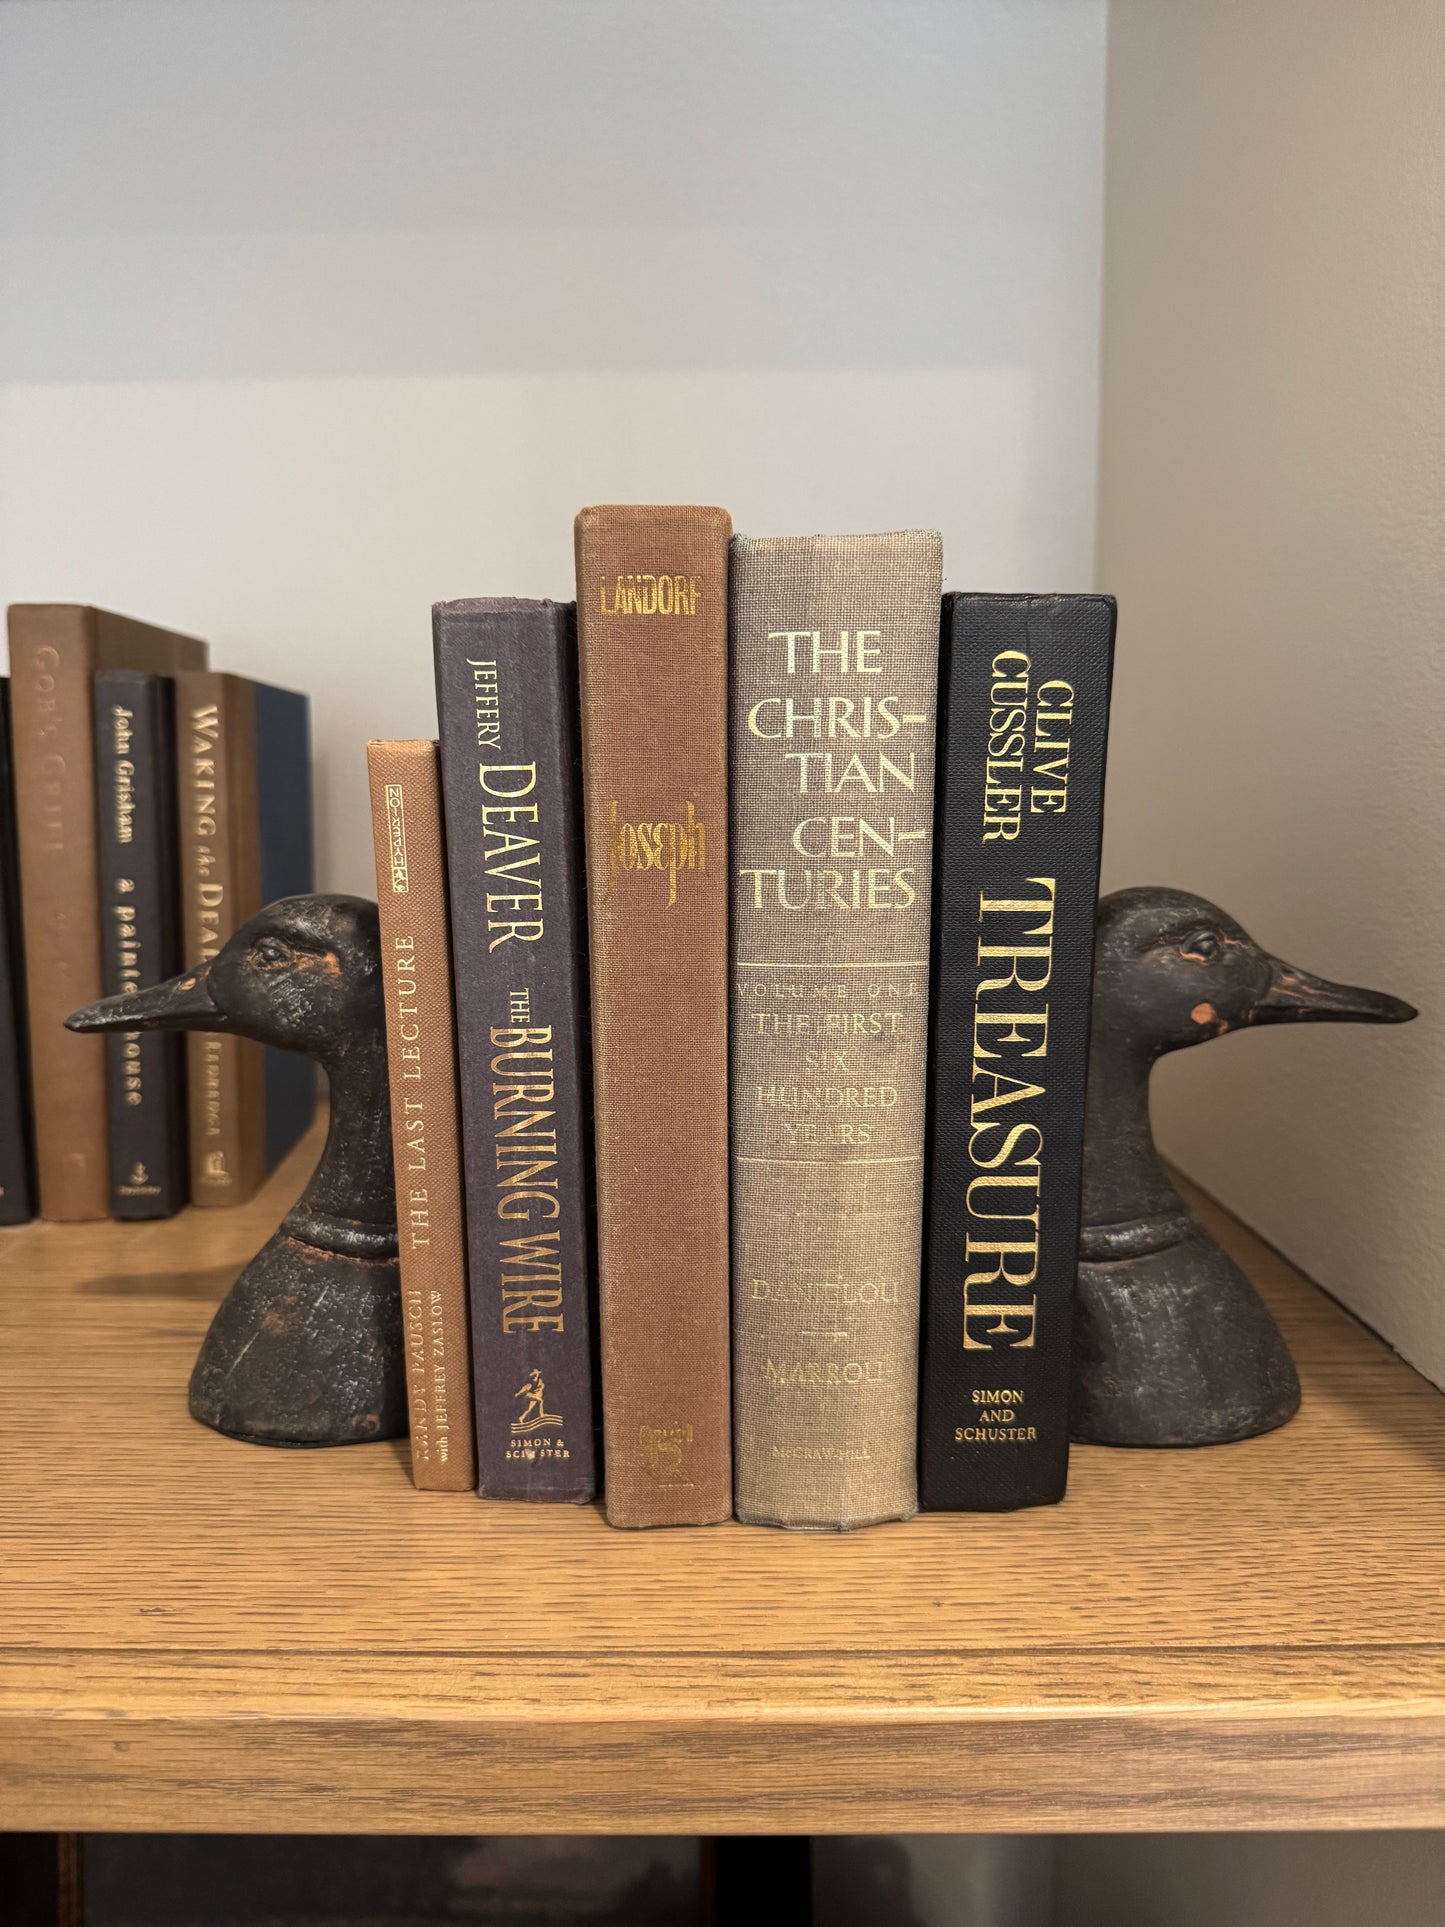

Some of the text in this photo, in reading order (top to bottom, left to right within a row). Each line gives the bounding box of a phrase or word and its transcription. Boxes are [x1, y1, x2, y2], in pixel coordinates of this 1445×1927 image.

[600, 575, 701, 615] LANDORF
[768, 630, 883, 674] THE
[748, 696, 927, 739] CHRIS-
[981, 650, 1031, 844] CUSSLER
[1031, 680, 1075, 813] CLIVE
[112, 704, 136, 843] John Grisham
[191, 704, 219, 836] WAKING
[785, 752, 915, 793] TIAN
[389, 787, 404, 866] HYPERION
[466, 658, 544, 953] JEFFERY DEAVER
[608, 800, 707, 910] Joseph
[793, 816, 926, 857] CEN-
[196, 845, 216, 877] the
[116, 878, 136, 893] a
[740, 868, 916, 910] TURIES
[115, 905, 141, 994] painte
[751, 1012, 903, 1034] THE FIRST
[805, 1050, 850, 1071] SIX
[395, 935, 430, 1250] THE LAST LECTURE
[756, 1086, 899, 1107] HUNDRED
[963, 877, 1056, 1350] TREASURE
[490, 987, 565, 1334] THE BURNING WIRE
[431, 1290, 450, 1463] with JEFFREY ZASLOW
[972, 1389, 1024, 1403] SIMON
[955, 1427, 1036, 1441] SCHUSTER
[979, 1409, 1016, 1422] AND
[505, 1449, 571, 1459] SCSTER
[511, 1438, 564, 1447] SIMON &
